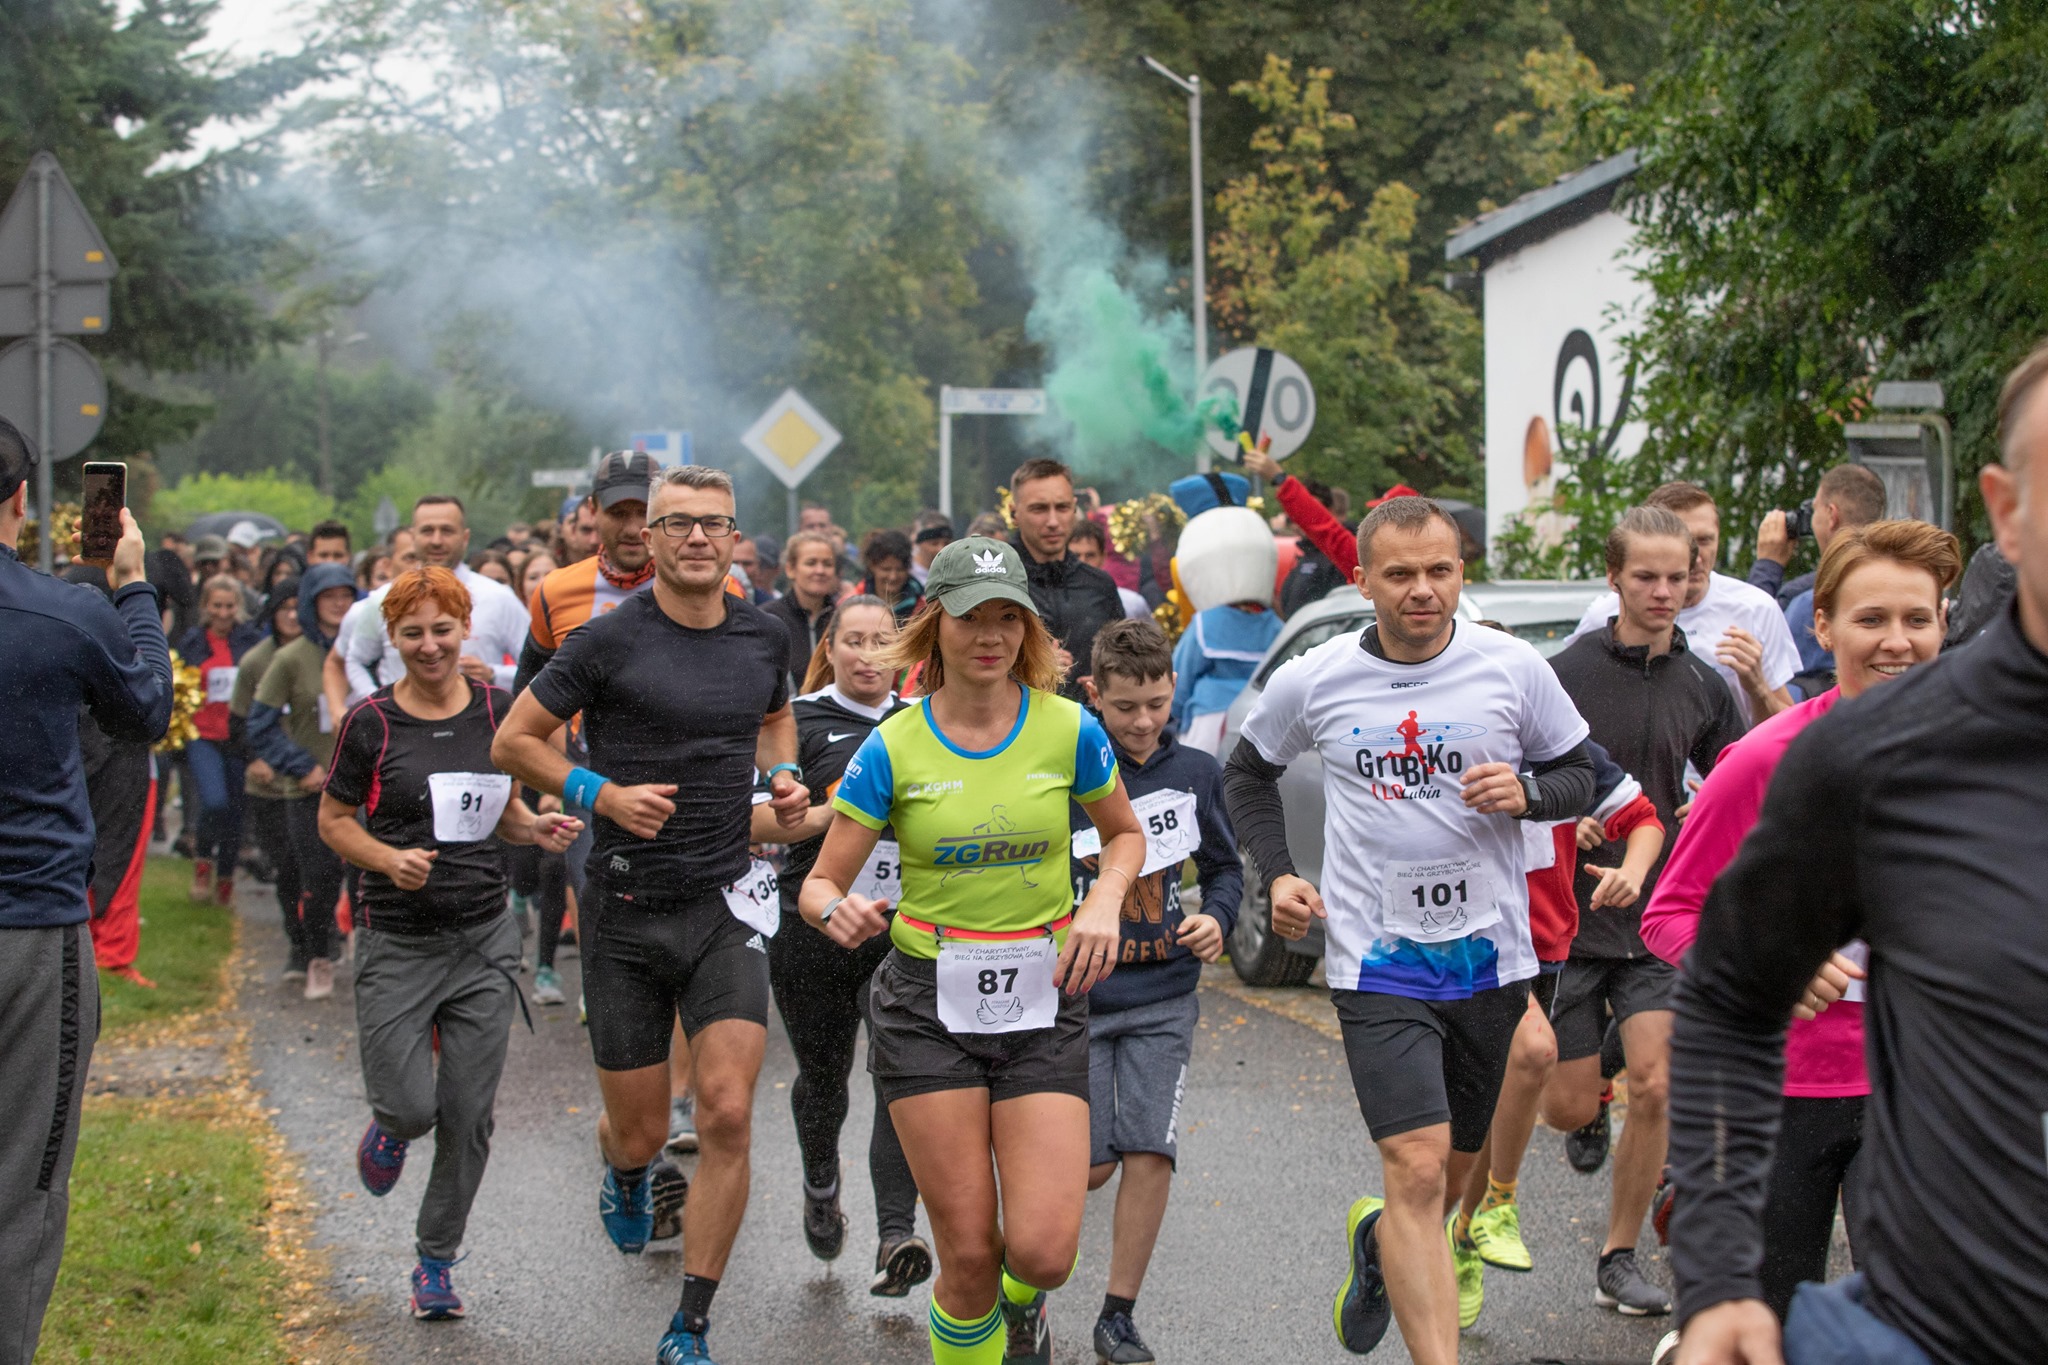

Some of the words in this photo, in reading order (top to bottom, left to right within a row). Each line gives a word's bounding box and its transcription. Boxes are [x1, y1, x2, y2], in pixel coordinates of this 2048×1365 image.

[974, 564, 1007, 574] adidas
[924, 780, 963, 793] KGHM
[461, 791, 484, 812] 91
[1148, 809, 1179, 836] 58
[933, 840, 1050, 866] ZGRun
[875, 861, 902, 880] 51
[748, 873, 778, 906] 136
[1412, 879, 1467, 908] 101
[977, 967, 1019, 996] 87
